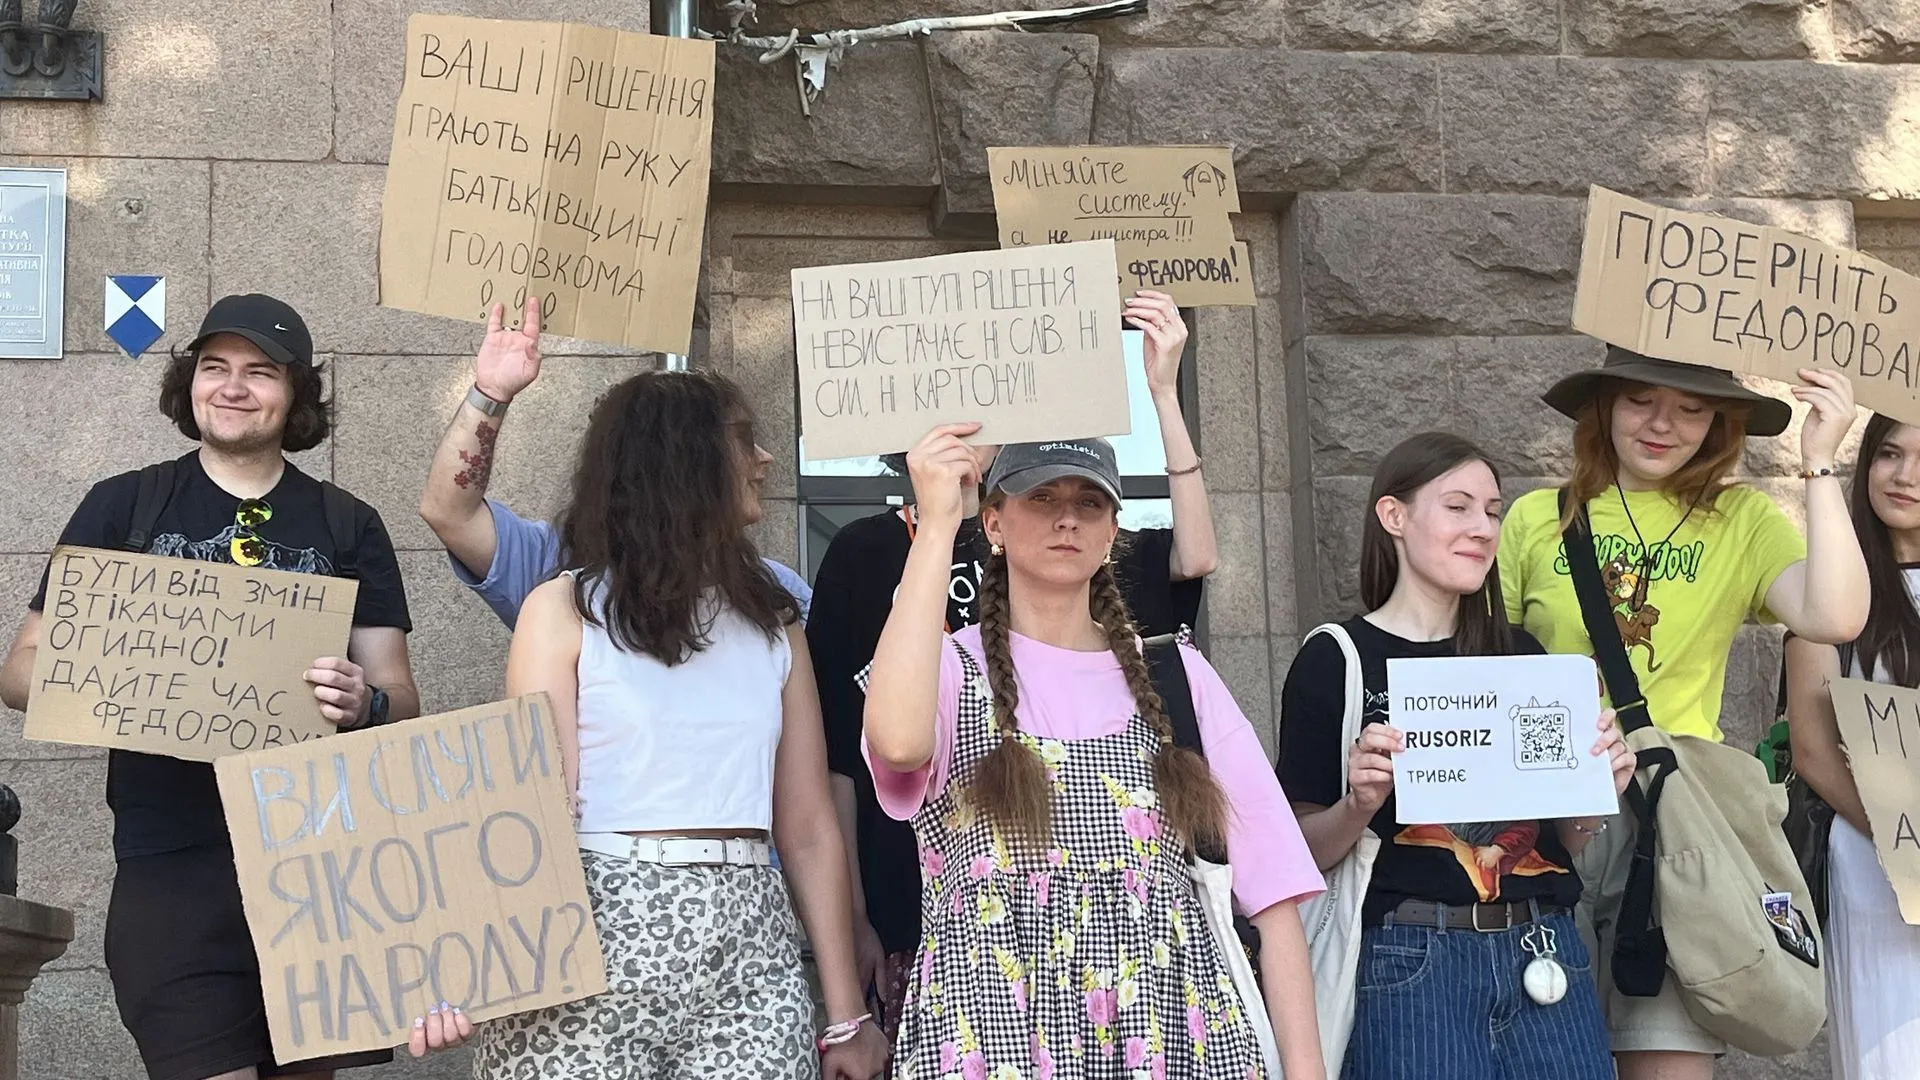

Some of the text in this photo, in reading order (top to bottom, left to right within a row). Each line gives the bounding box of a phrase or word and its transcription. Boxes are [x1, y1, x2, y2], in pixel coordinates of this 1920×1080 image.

[567, 56, 707, 119] РІШЕННЯ
[408, 103, 692, 188] ГРАЮТЬ НА РУКУ
[1003, 156, 1128, 189] Міняйте
[447, 168, 684, 256] БАТЬКІВЩИНІ
[1011, 230, 1030, 245] а
[1048, 229, 1073, 245] не
[446, 229, 645, 302] ГОЛОВКОМА
[801, 279, 837, 321] НА
[849, 278, 907, 319] ВАШІ
[972, 265, 1076, 310] РІШЕННЯ
[1128, 246, 1239, 287] ФЕДОРОВА!
[811, 322, 976, 370] НЕВИСТАЧАЄ
[815, 376, 869, 418] СИЛ,
[912, 361, 1038, 412] КАРТОНУ!!!
[60, 555, 157, 595] БУТИ
[50, 619, 229, 668] ОГИДНО!
[42, 659, 288, 717] ДАЙТЕ ЧАС
[1404, 691, 1498, 712] ПОТОЧНИЙ
[1405, 729, 1492, 749] RUSORIZ
[250, 702, 551, 853] ВИ СЛУГИ
[1407, 769, 1467, 784] ТРИВАЄ
[267, 810, 542, 948] ЯКОГО
[284, 902, 587, 1047] НАРОДУ?
